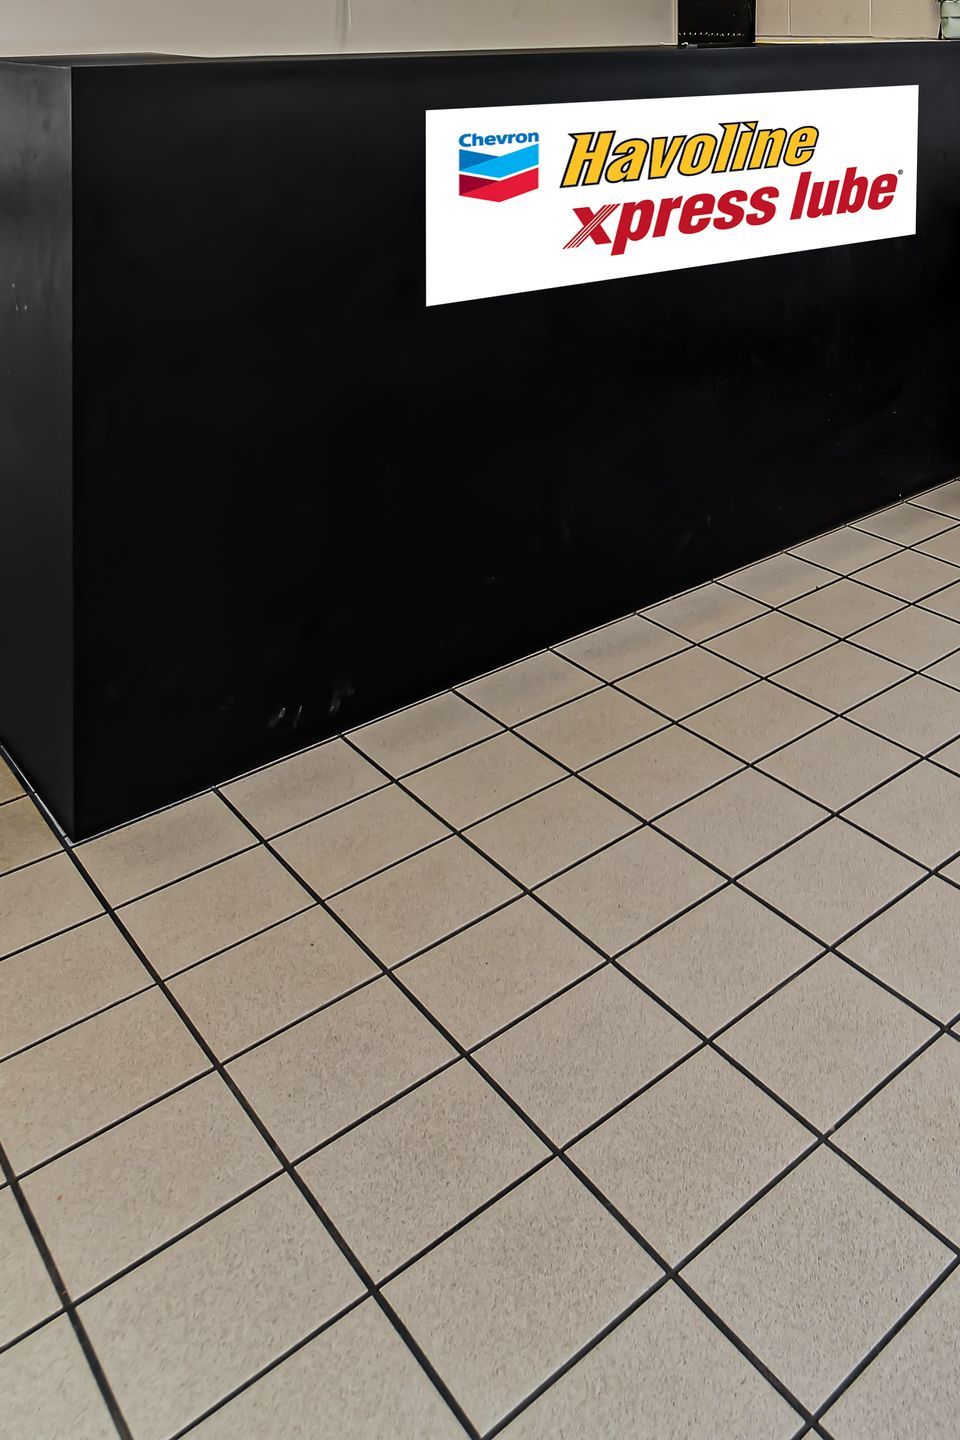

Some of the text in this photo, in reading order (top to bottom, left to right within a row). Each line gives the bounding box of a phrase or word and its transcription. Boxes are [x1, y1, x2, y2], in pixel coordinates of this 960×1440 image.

[458, 131, 540, 148] Chevron
[560, 120, 820, 189] Havoline
[563, 185, 780, 256] xpress
